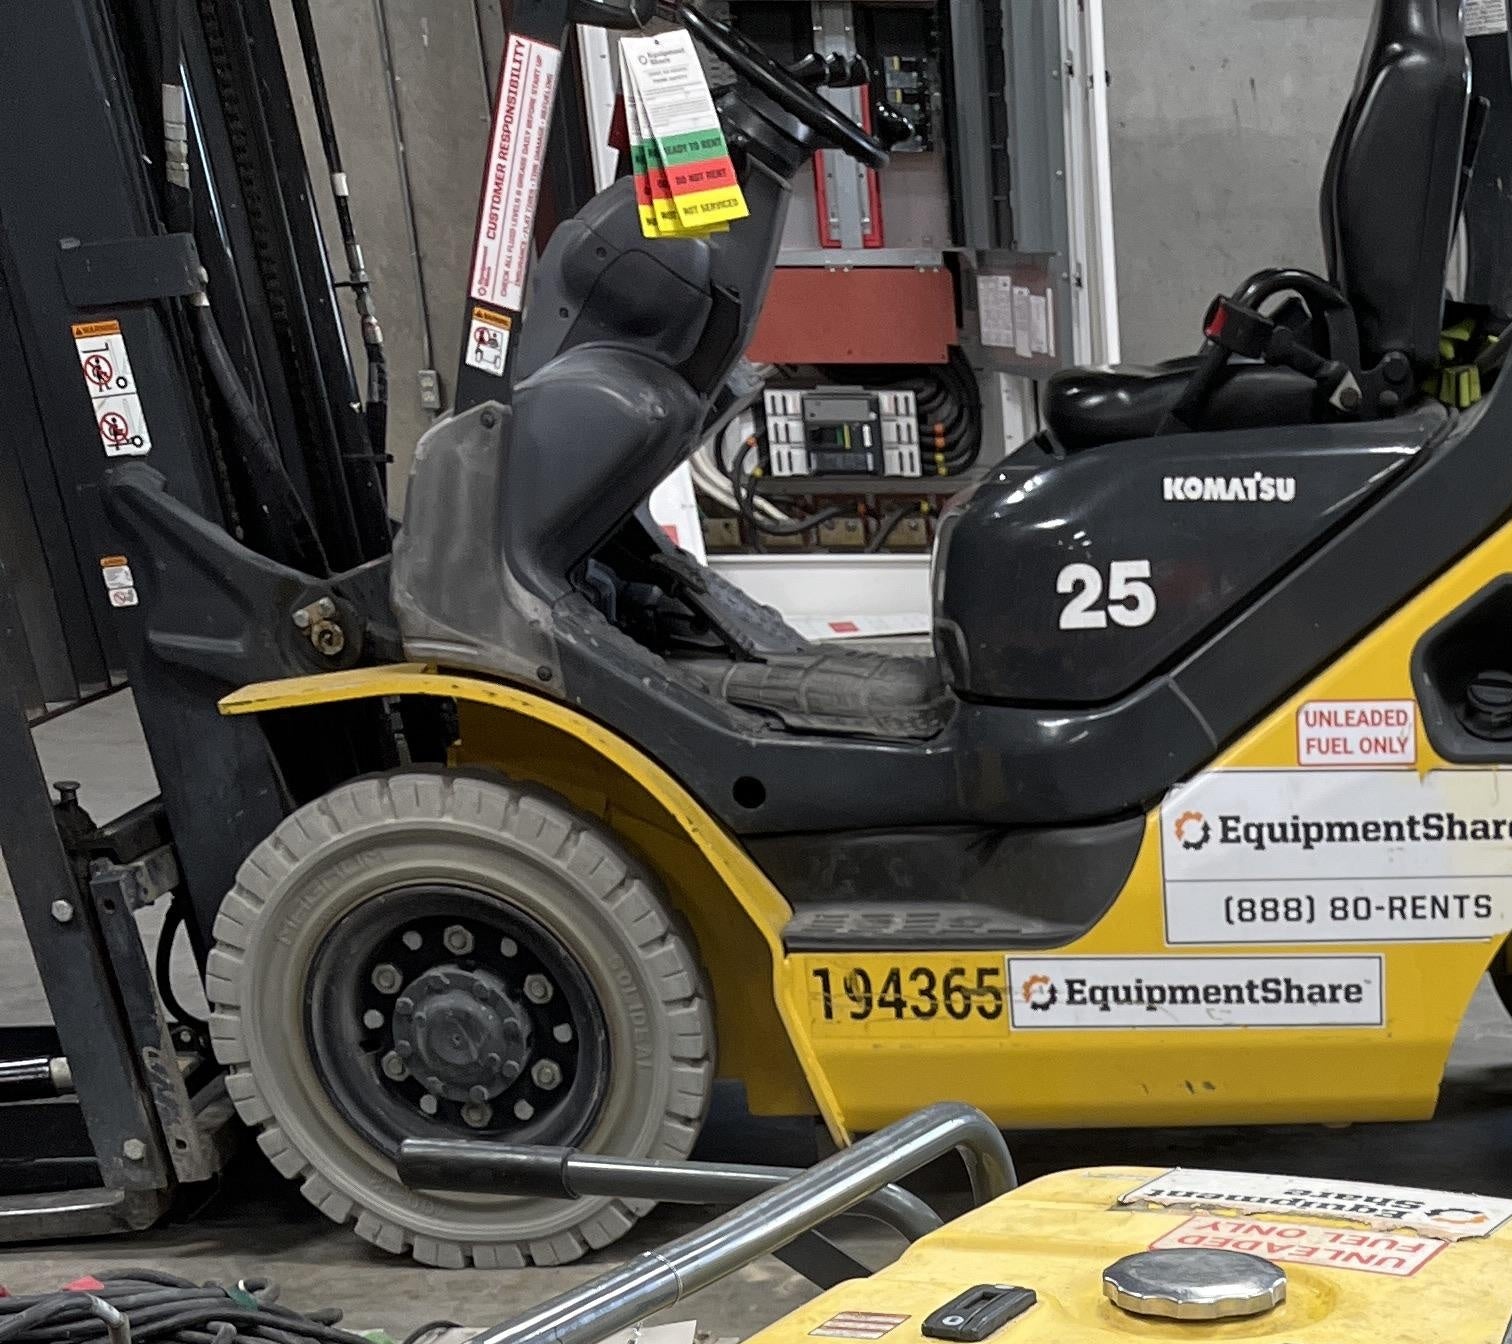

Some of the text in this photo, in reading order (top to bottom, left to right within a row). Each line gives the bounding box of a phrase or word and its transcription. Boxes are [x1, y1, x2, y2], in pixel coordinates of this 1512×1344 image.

[485, 39, 525, 241] CUSTOMER RESPONSIBILITY
[1163, 471, 1295, 501] KOMATSU
[1056, 559, 1157, 629] 25
[1304, 709, 1408, 727] UNLEADED
[1305, 736, 1409, 755] FUEL ONLY
[1224, 894, 1492, 924] (888) 80-RENTS
[812, 967, 1002, 1021] 194365
[1065, 977, 1363, 1011] EquipmentShare
[1148, 1189, 1407, 1220] Equipment
[1283, 1189, 1426, 1210] Share
[1178, 1234, 1406, 1268] UNLEADED
[1199, 1222, 1423, 1253] FUEL ONLY
